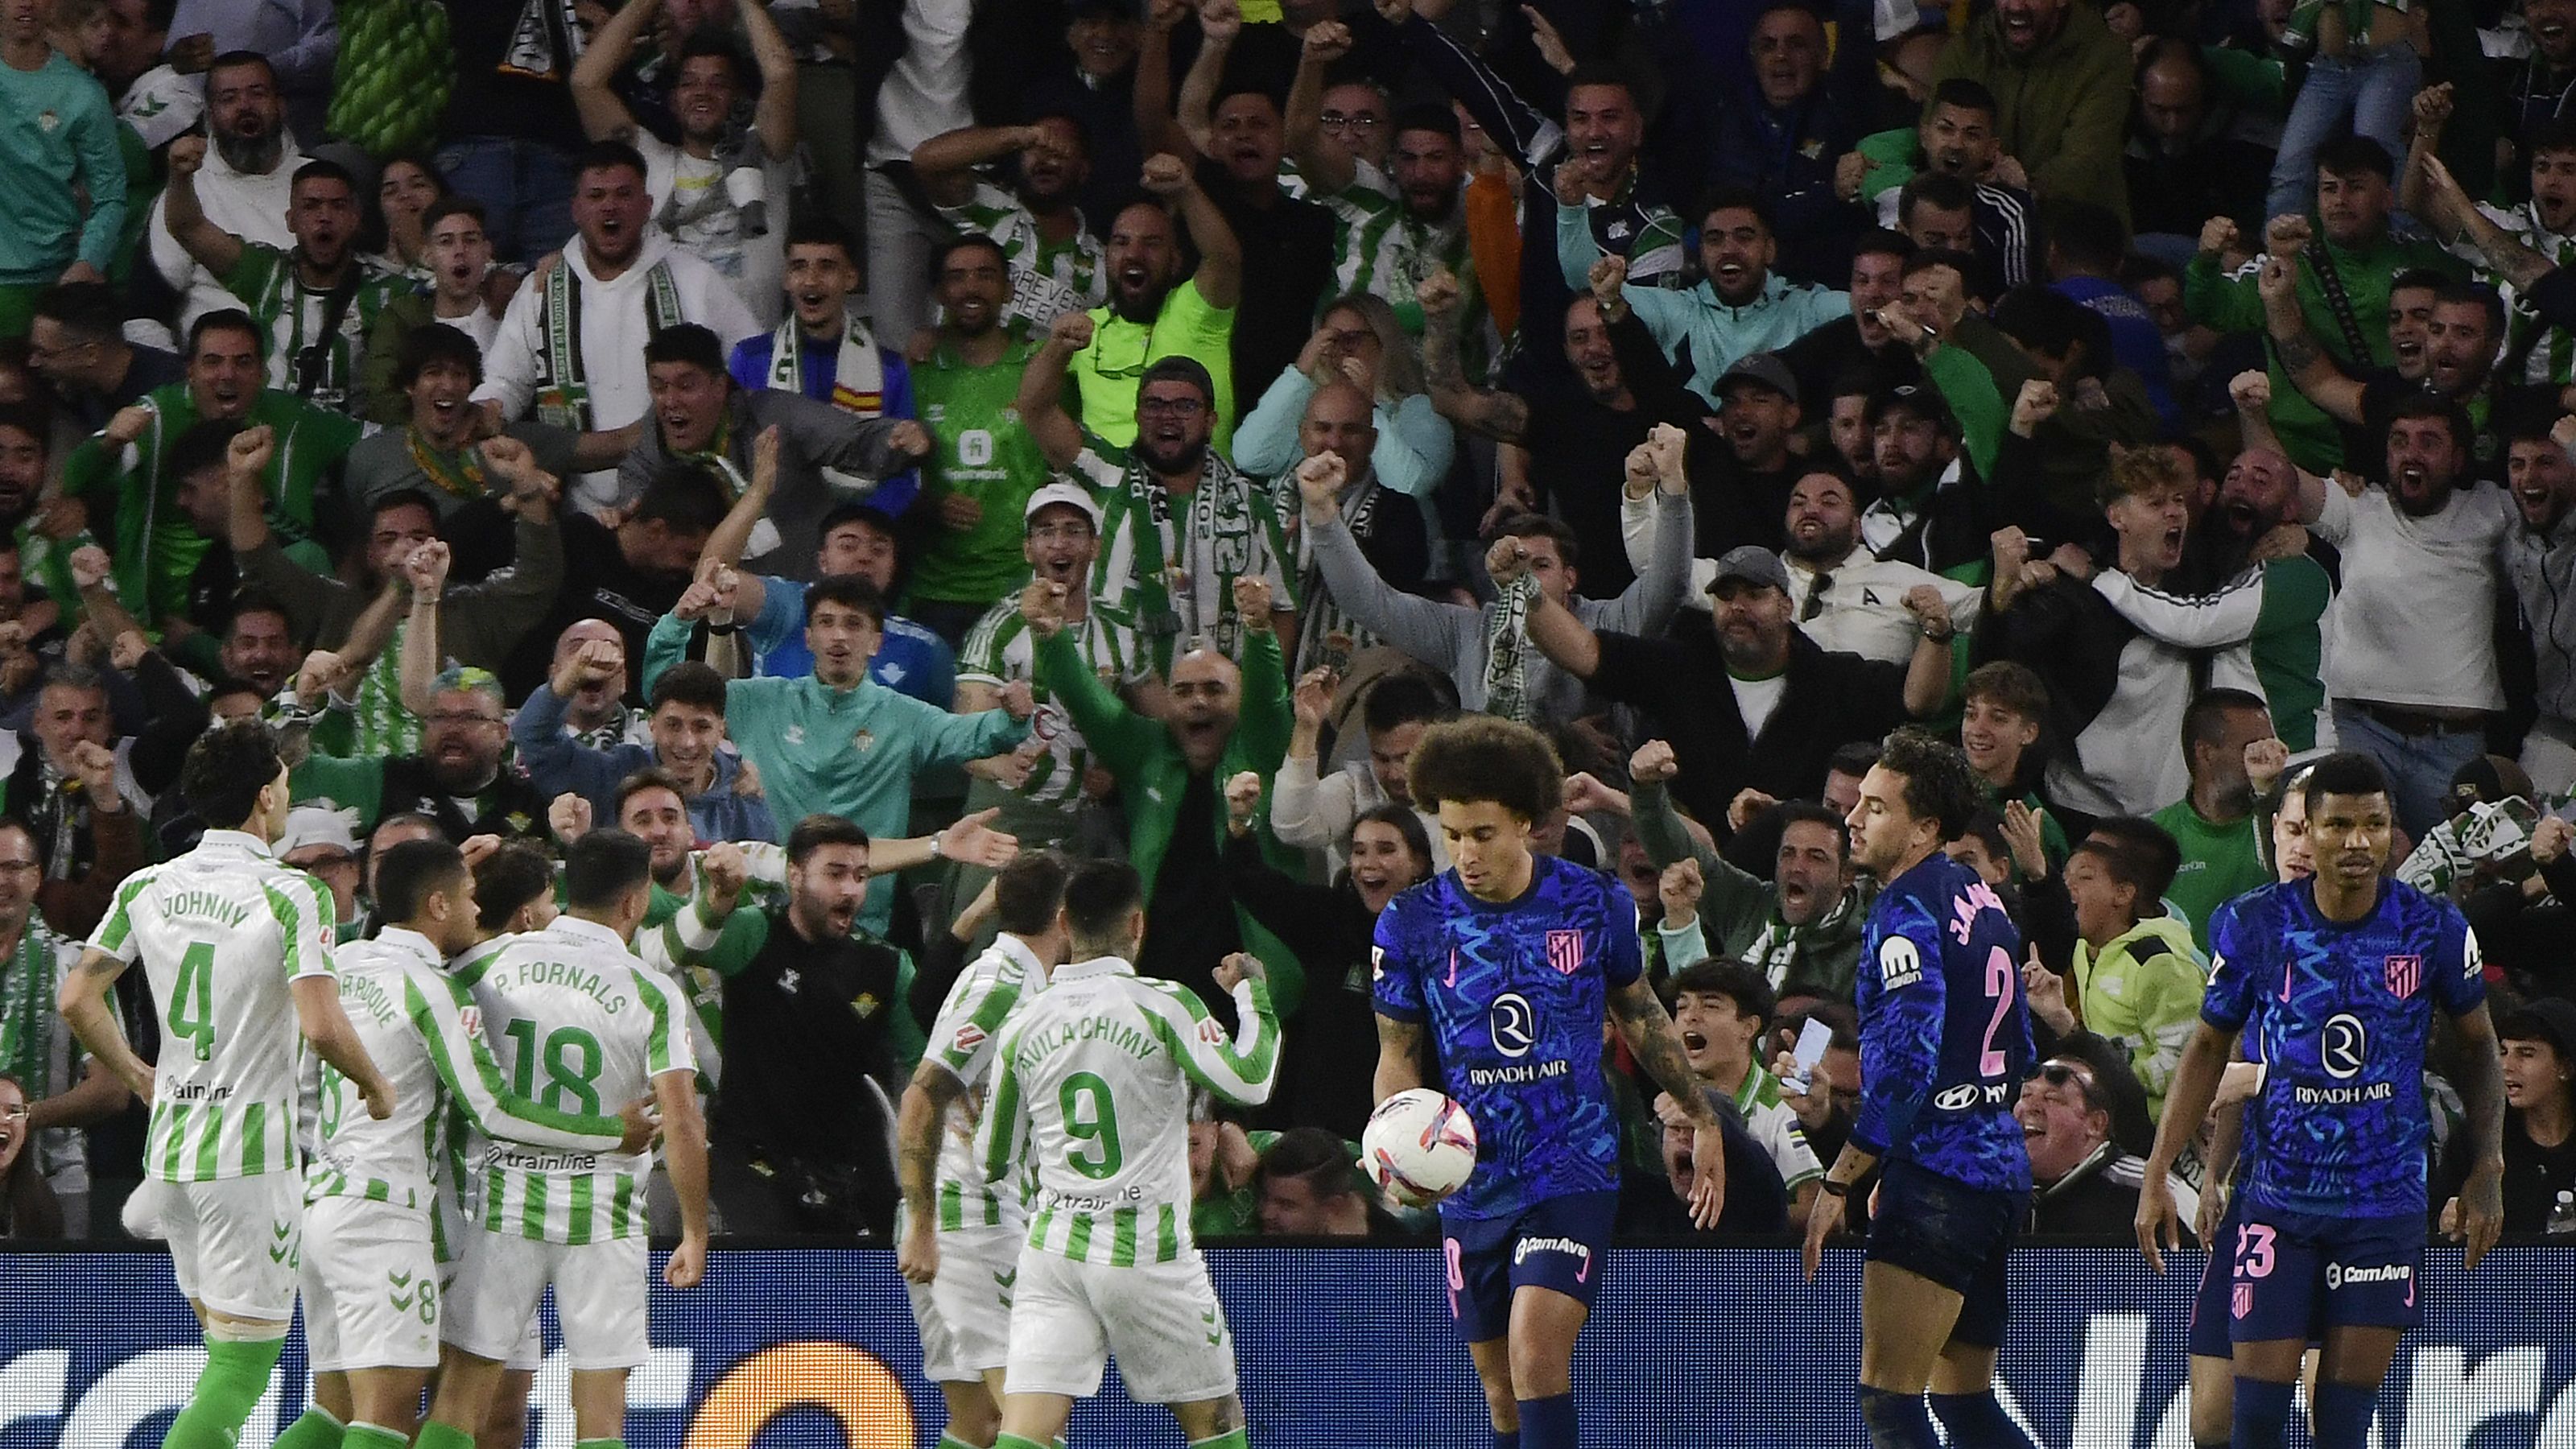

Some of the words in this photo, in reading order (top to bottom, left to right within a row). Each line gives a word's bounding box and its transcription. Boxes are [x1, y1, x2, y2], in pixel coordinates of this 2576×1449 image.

[1863, 587, 1880, 605] A
[162, 891, 249, 929] JOHNNY
[167, 941, 215, 1061] 4
[519, 962, 626, 1014] FORNALS
[1979, 945, 2014, 1078] 2
[505, 1018, 602, 1117] 18
[1470, 1065, 1534, 1085] RIYADH
[1538, 1059, 1568, 1077] AIR
[2296, 1086, 2359, 1104] RIYADH
[2363, 1083, 2392, 1100] AIR
[1059, 1071, 1122, 1179] 9
[505, 1151, 597, 1170] trainline
[1526, 1237, 1588, 1258] ComAve
[2344, 1265, 2410, 1283] ComAve
[418, 1278, 436, 1325] 8
